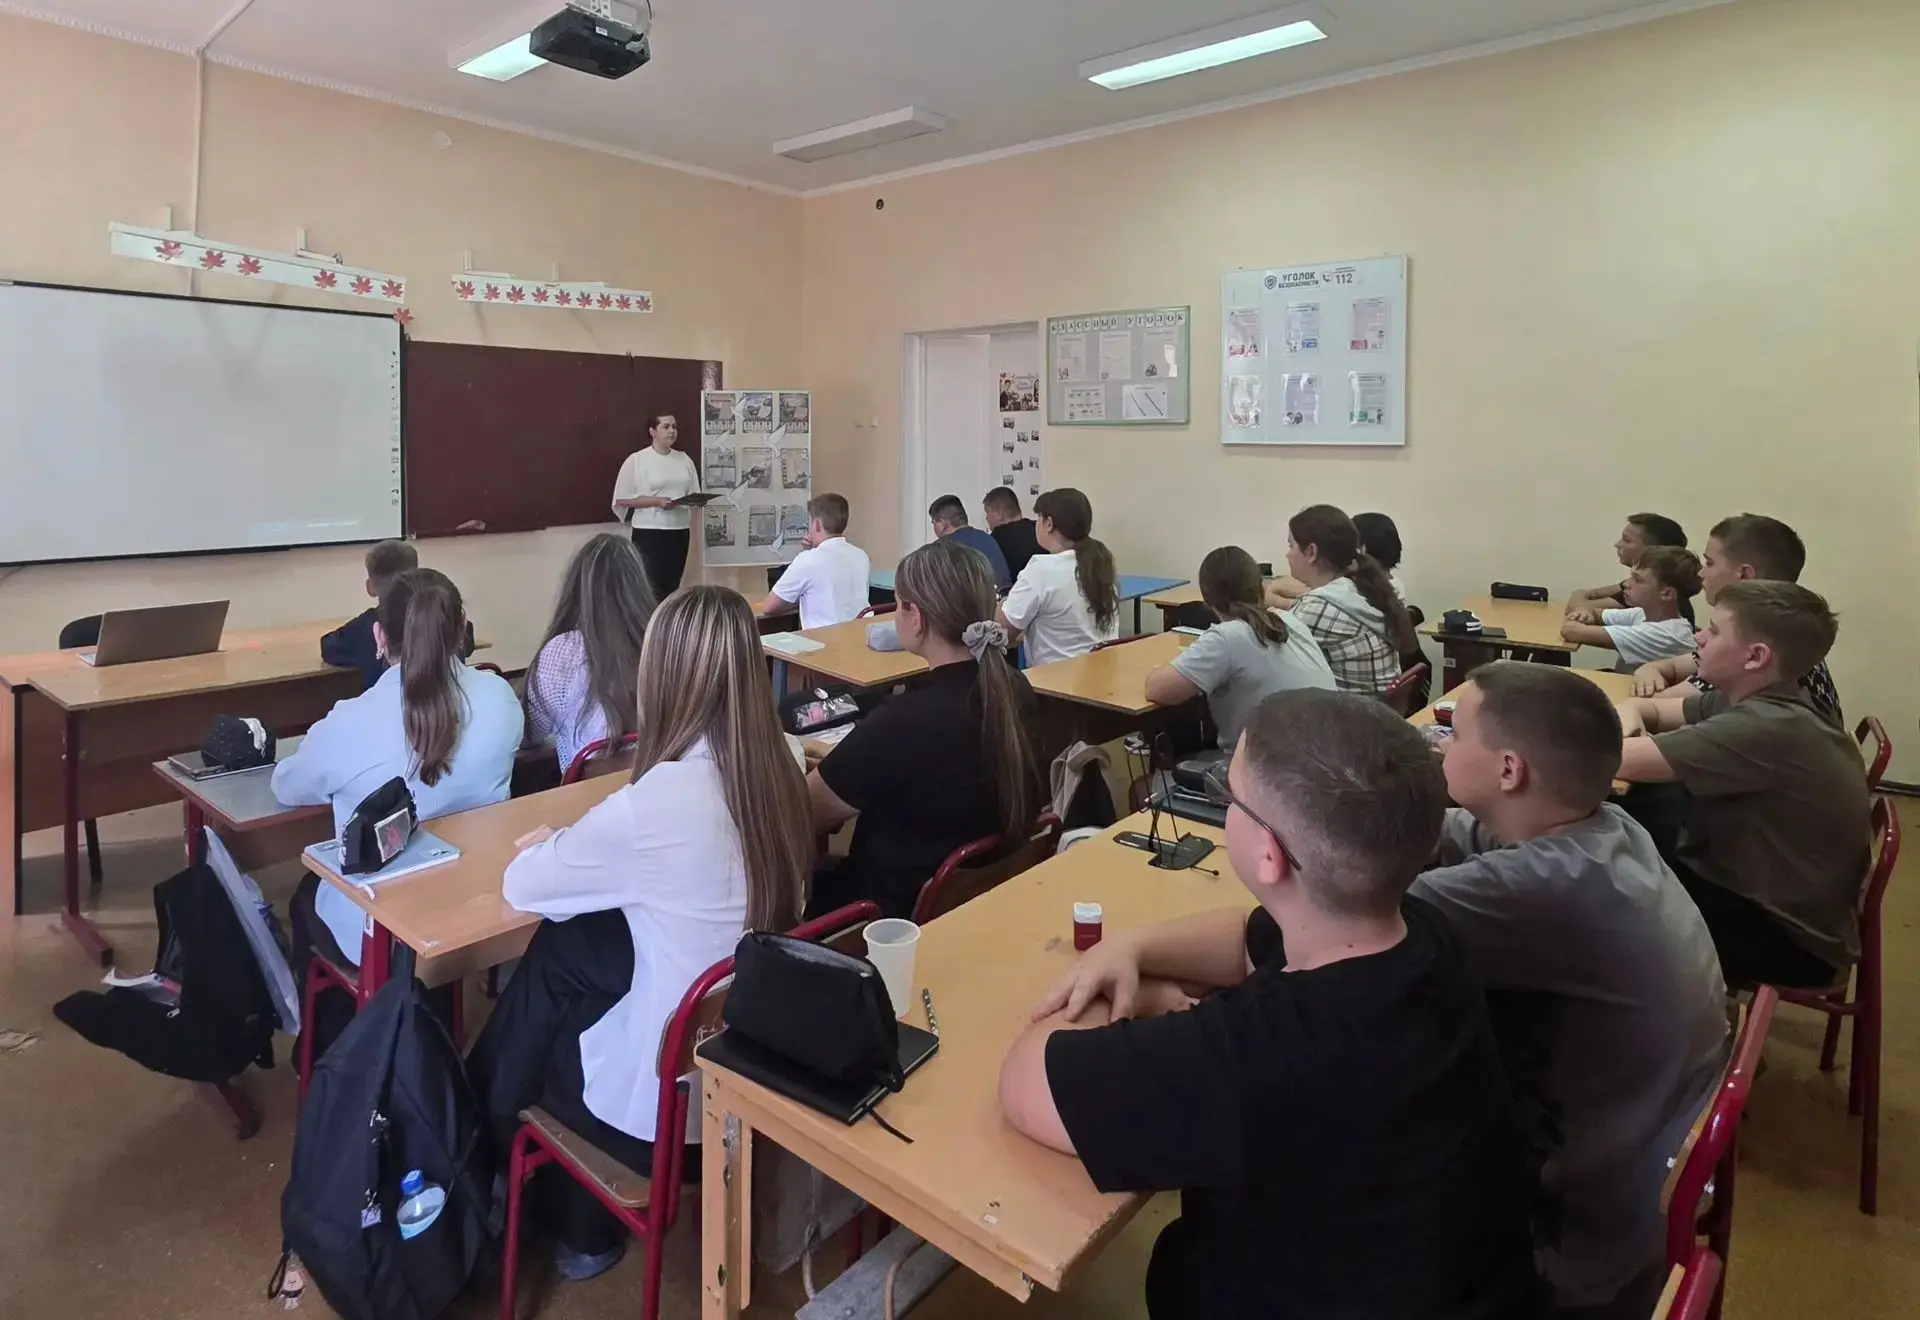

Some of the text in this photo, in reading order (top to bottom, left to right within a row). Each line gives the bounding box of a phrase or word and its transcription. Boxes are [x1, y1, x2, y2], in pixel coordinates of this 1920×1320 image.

[1282, 271, 1315, 281] УГОЛОК
[1335, 273, 1353, 284] 112
[1278, 280, 1319, 288] БЕЗОПАСНОСТИ
[1051, 314, 1184, 332] КЛАССНЫЙ УГОЛОК
